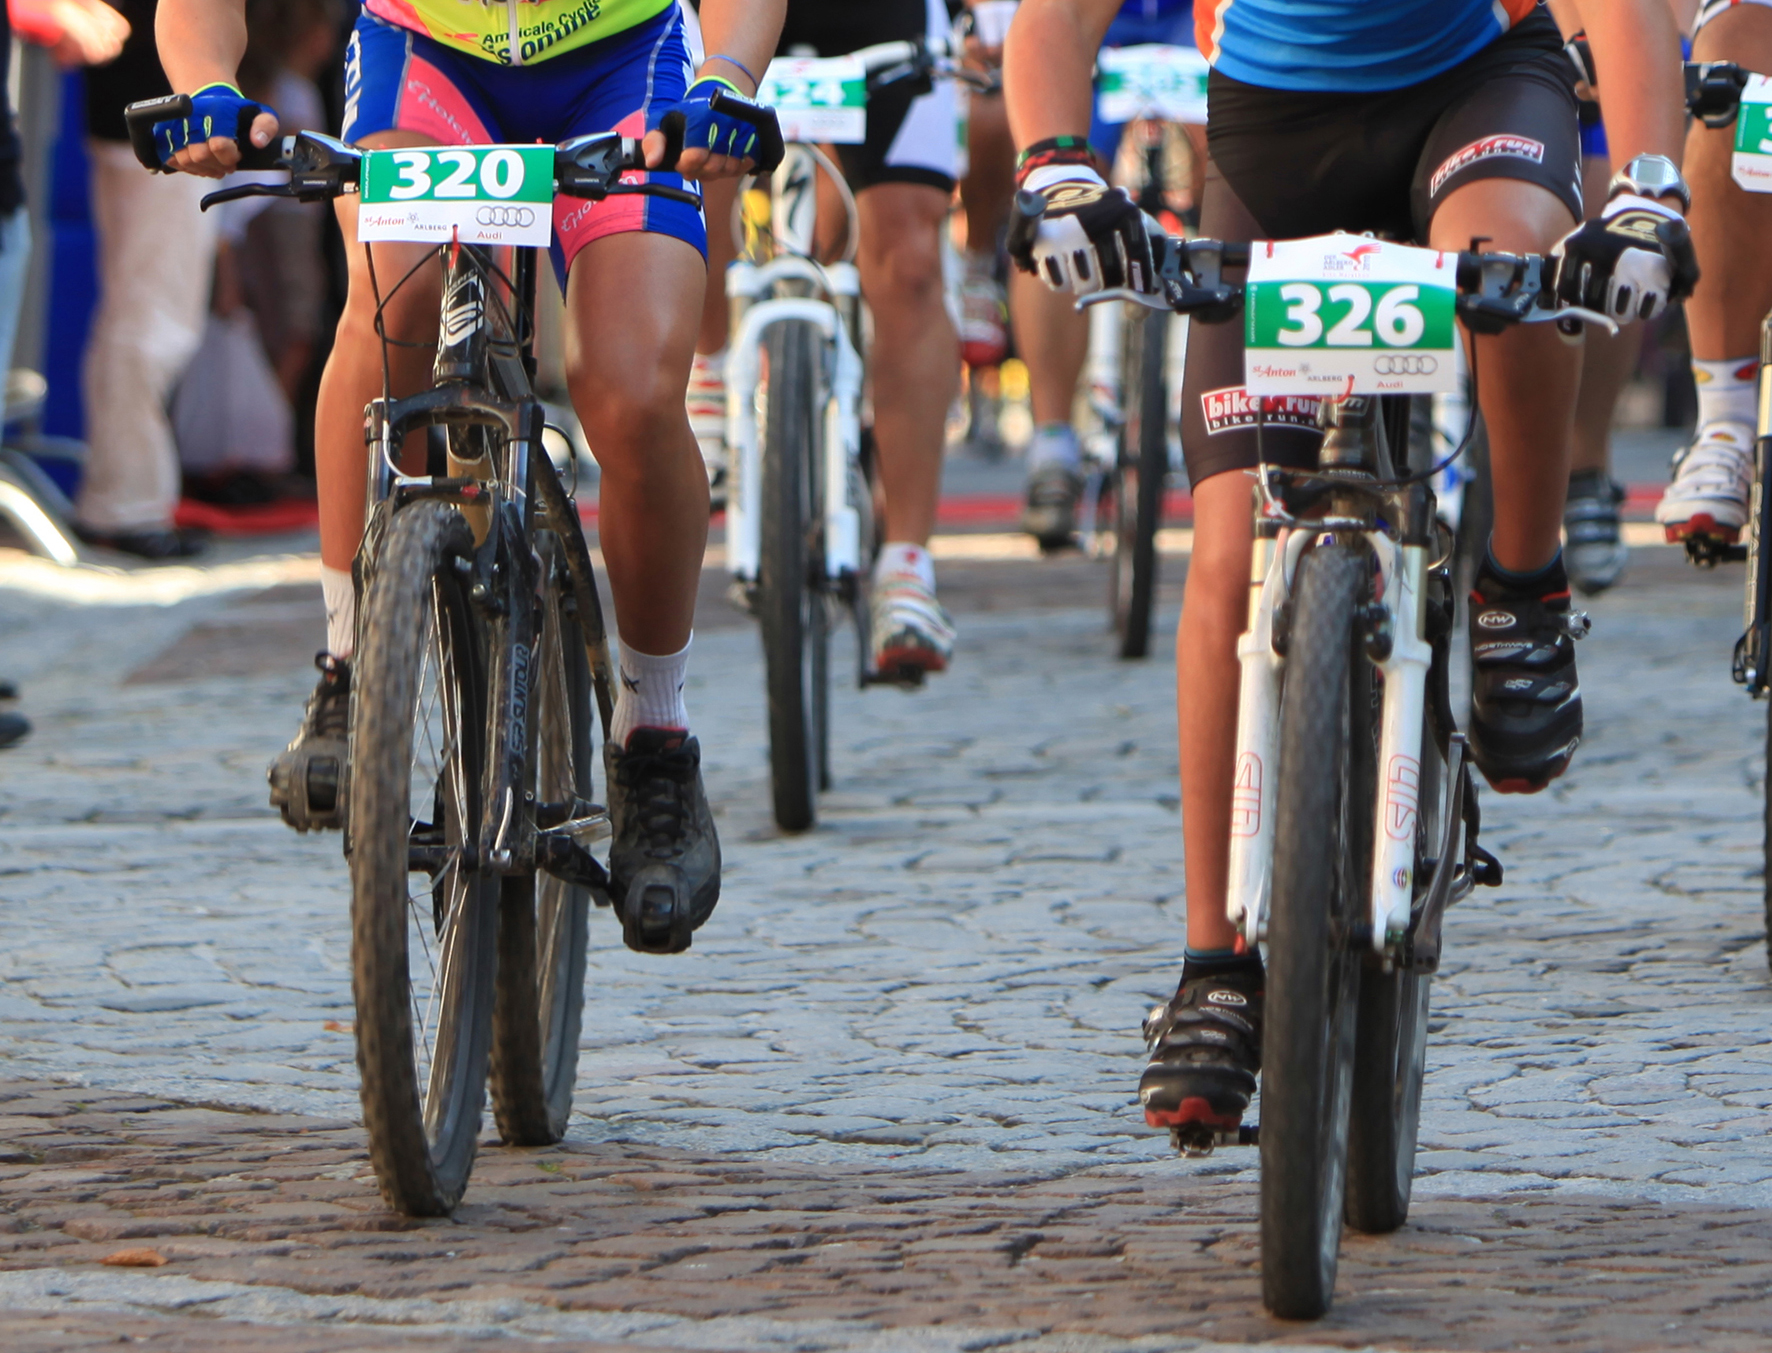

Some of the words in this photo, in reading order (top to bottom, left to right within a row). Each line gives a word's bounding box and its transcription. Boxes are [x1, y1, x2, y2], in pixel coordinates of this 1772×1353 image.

[389, 149, 525, 199] 320
[477, 230, 503, 239] Audi
[1278, 283, 1424, 347] 326
[1259, 365, 1296, 377] Anton
[1209, 393, 1260, 419] bike
[1213, 415, 1254, 429] bike
[1483, 615, 1511, 624] NW
